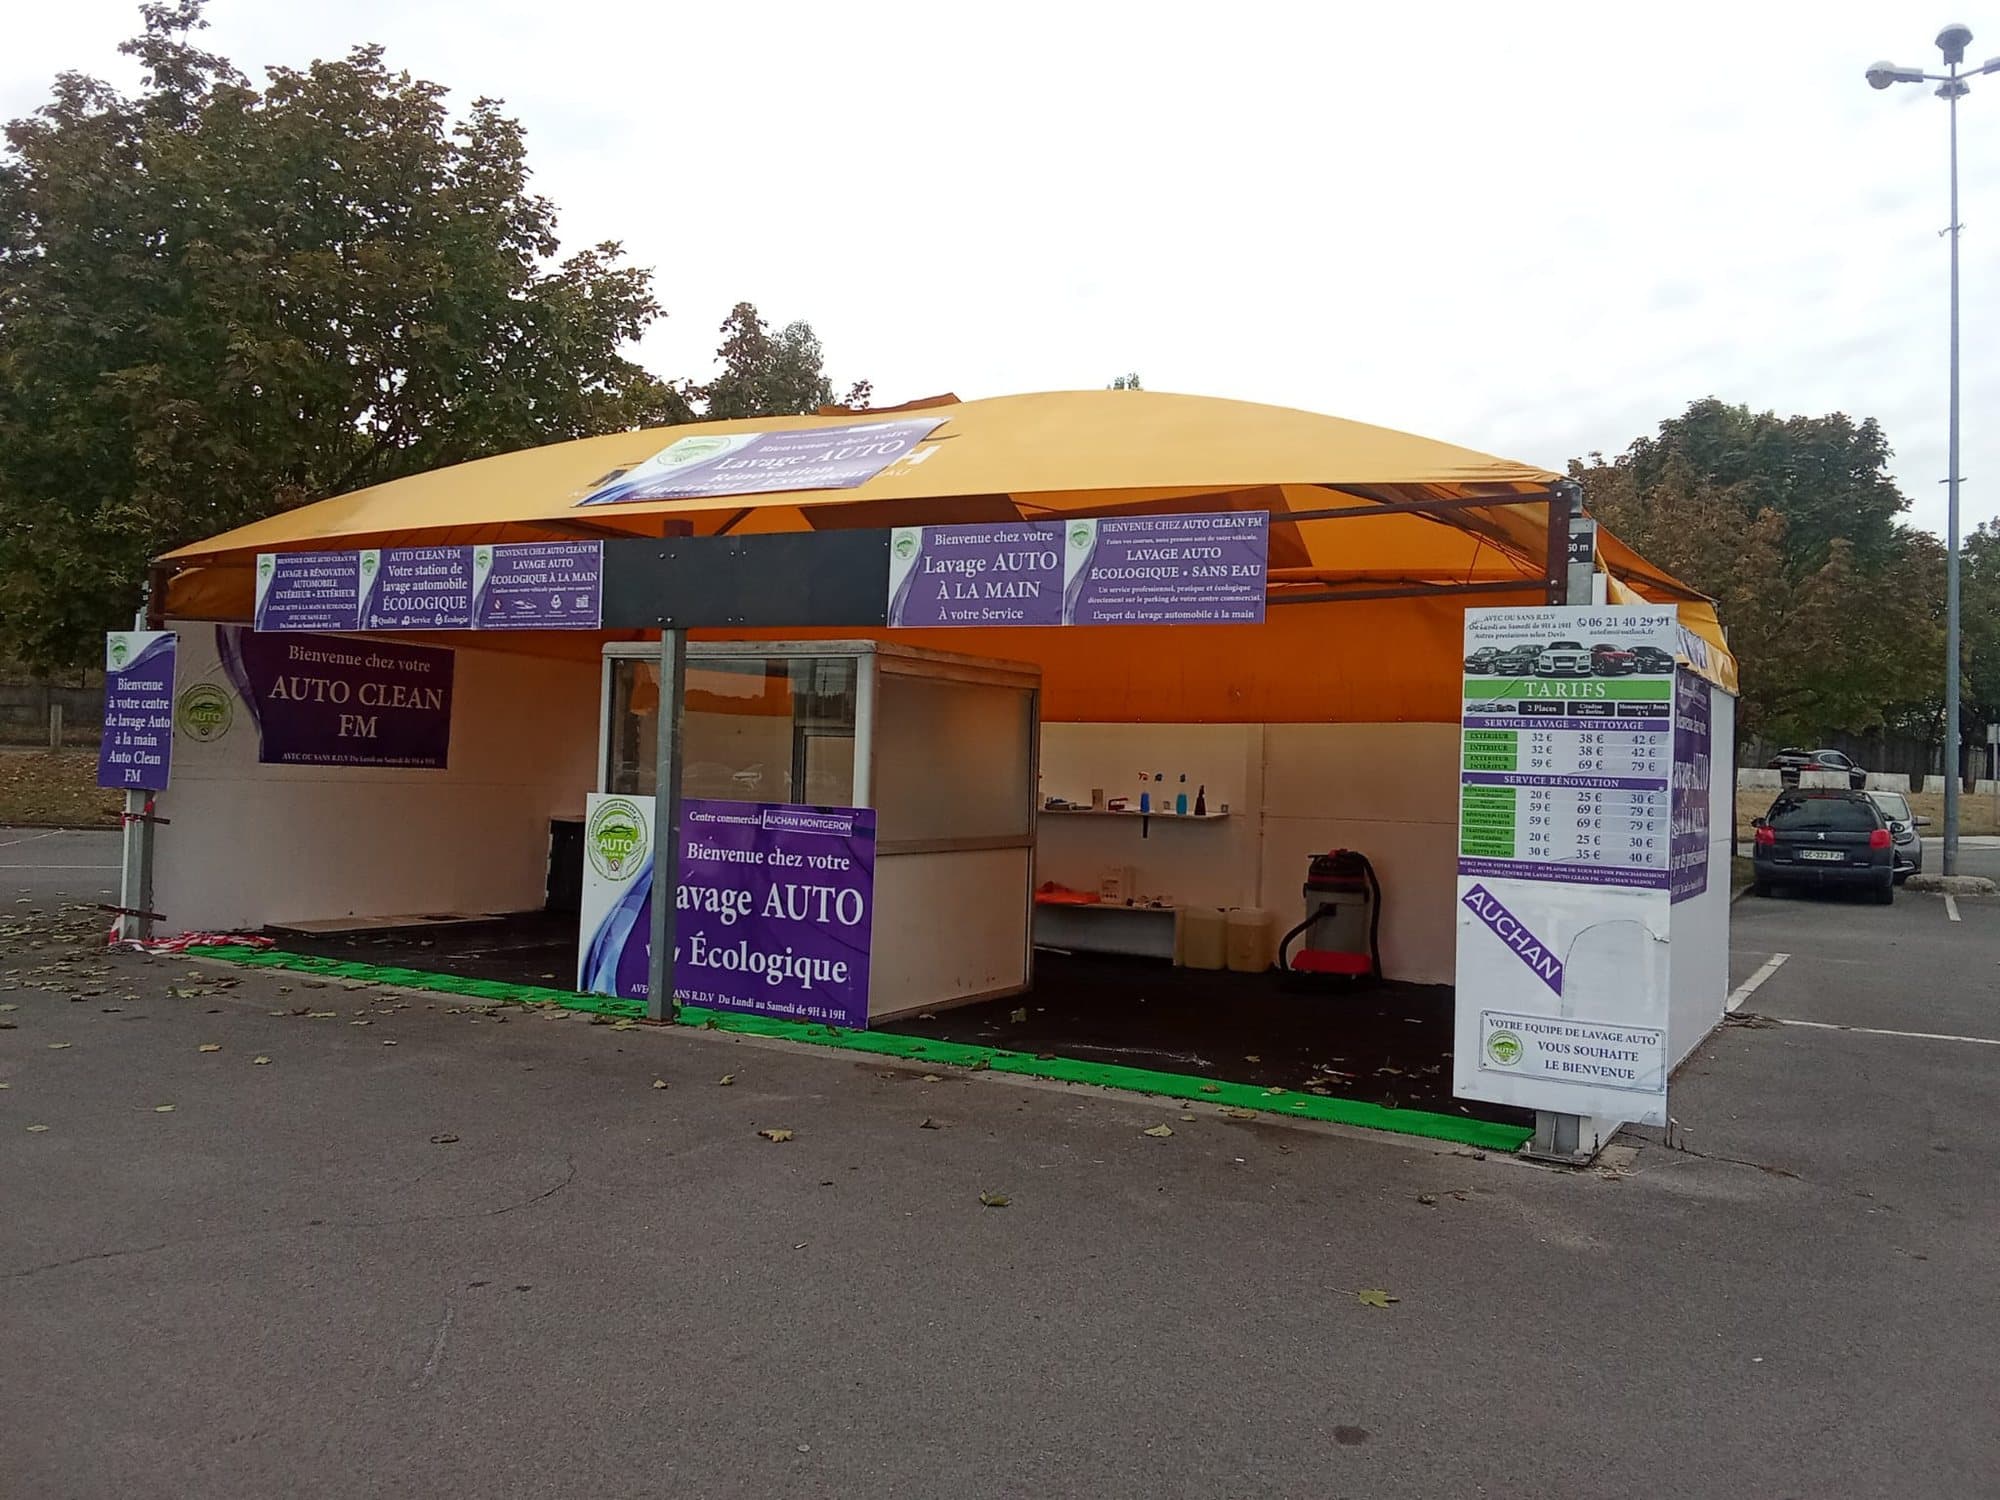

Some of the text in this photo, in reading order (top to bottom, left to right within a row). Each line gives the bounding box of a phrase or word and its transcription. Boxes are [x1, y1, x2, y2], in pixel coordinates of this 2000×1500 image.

[713, 456, 806, 471] Lavage
[810, 440, 905, 463] AUTO
[1103, 517, 1262, 532] BIENVENUE CHEZ AUTO CLEAN FM
[935, 531, 1054, 546] Bienvenue chez votre
[496, 545, 598, 557] BIENVENUE CHEZ AUTO CLEAN FM
[1126, 547, 1222, 561] LAVAGE AUTO
[1579, 544, 1589, 552] m
[390, 549, 461, 562] AUTO CLEAN FM
[388, 562, 463, 577] Votre station de
[513, 558, 574, 570] LAVAGE AUTO
[924, 551, 1058, 578] Lavage AUTO
[277, 569, 302, 578] LAVAGE
[310, 568, 356, 577] RÉNOVATION
[491, 571, 598, 585] ÉCOLOGIQUE À LA MAIN
[1091, 564, 1261, 581] ÉCOLOGIQUE SANS EAU
[293, 578, 338, 588] AUTOMOBILE
[383, 578, 468, 594] lavage automobile
[936, 580, 1041, 600] À LA MAIN
[1177, 585, 1205, 594] pratique
[276, 588, 356, 599] INTÉRIEUR EXTÉRIEUR
[383, 595, 467, 612] ÉCOLOGIQUE
[938, 606, 1024, 621] À votre Service
[1125, 610, 1135, 619] du
[1137, 610, 1163, 621] lavage
[1164, 609, 1212, 619] automobile
[1213, 609, 1219, 618] à
[1221, 610, 1230, 618] la
[1232, 609, 1254, 619] main
[378, 616, 398, 626] Qualité
[411, 616, 431, 624] Service
[1588, 616, 1670, 627] 06 21 40 29 91
[288, 644, 431, 673] Bienvenue chez votre
[117, 677, 164, 691] Bienvenue
[1524, 682, 1606, 698] TARIFS
[268, 675, 443, 711] AUTO CLEAN
[109, 696, 169, 710] à votre centre
[1534, 704, 1557, 713] Places
[105, 713, 171, 731] de lavage Auto
[189, 711, 222, 721] AUTO
[338, 714, 378, 738] FM
[1484, 719, 1644, 730] SERVICE LAVAGE NETTOYAGE
[115, 732, 157, 746] à la main
[1531, 733, 1553, 742] 32 €
[1578, 734, 1604, 744] 38 €
[1632, 735, 1656, 745] 42 €
[1531, 745, 1553, 754] 32 €
[1578, 746, 1604, 756] 38 €
[1631, 747, 1656, 757] 42 €
[108, 750, 161, 765] Auto Clean
[1531, 758, 1552, 768] 59 €
[1578, 759, 1604, 770] 69 €
[1631, 762, 1656, 771] 79 €
[124, 769, 141, 783] FM
[1504, 775, 1620, 788] SERVICE RÉNOVATION
[689, 811, 852, 831] Centre commercial AUCHAN MONTGERON
[600, 838, 633, 852] AUTO
[687, 842, 850, 871] Bienvenue chez votre
[676, 882, 864, 926] avage AUTO
[1465, 891, 1560, 980] AUCHAN
[688, 930, 848, 989] Écologique
[631, 984, 846, 1020] AVE ANS R.D.V Du Lundi au Samedi de 9H à 19H
[1489, 1019, 1656, 1046] VOTRE EQUIPE DE LAVAGE AUTO
[1538, 1041, 1639, 1062] VOUS SOUHAITE
[1545, 1060, 1636, 1080] LE BIENVENUE
